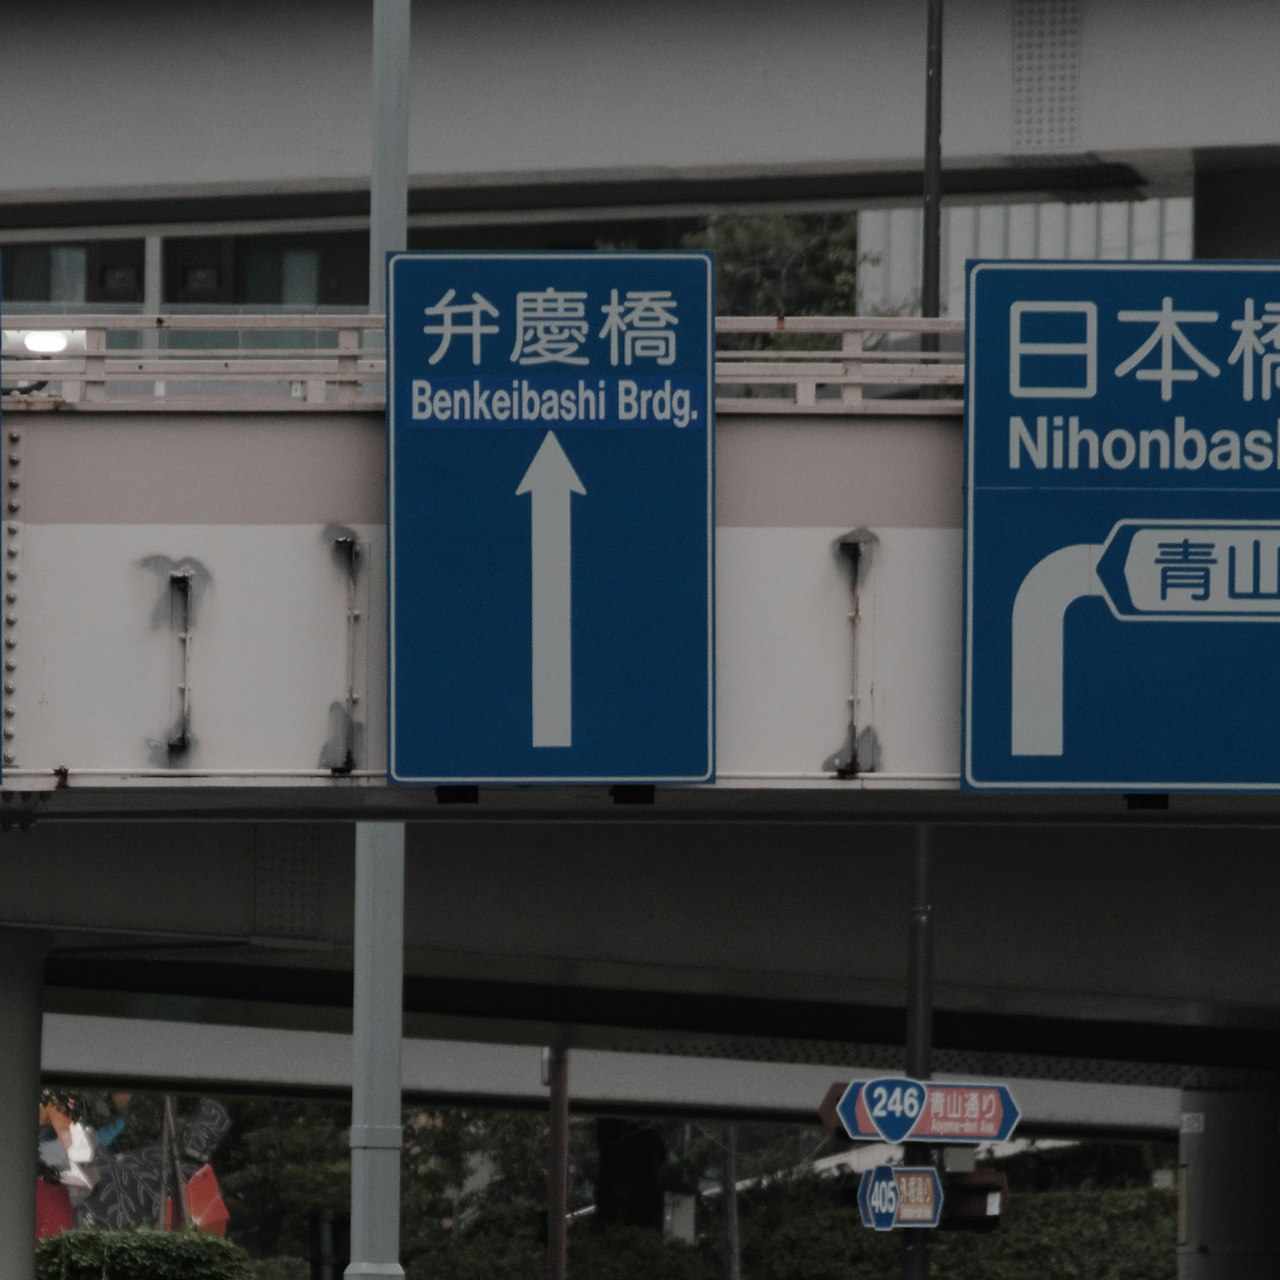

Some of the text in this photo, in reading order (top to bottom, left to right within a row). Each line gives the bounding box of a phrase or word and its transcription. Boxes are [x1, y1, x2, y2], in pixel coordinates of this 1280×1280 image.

[423, 287, 679, 366] 弁慶橋
[411, 379, 699, 428] Benkeibashi Brdg.
[872, 1087, 919, 1118] 246
[871, 1180, 896, 1214] 405
